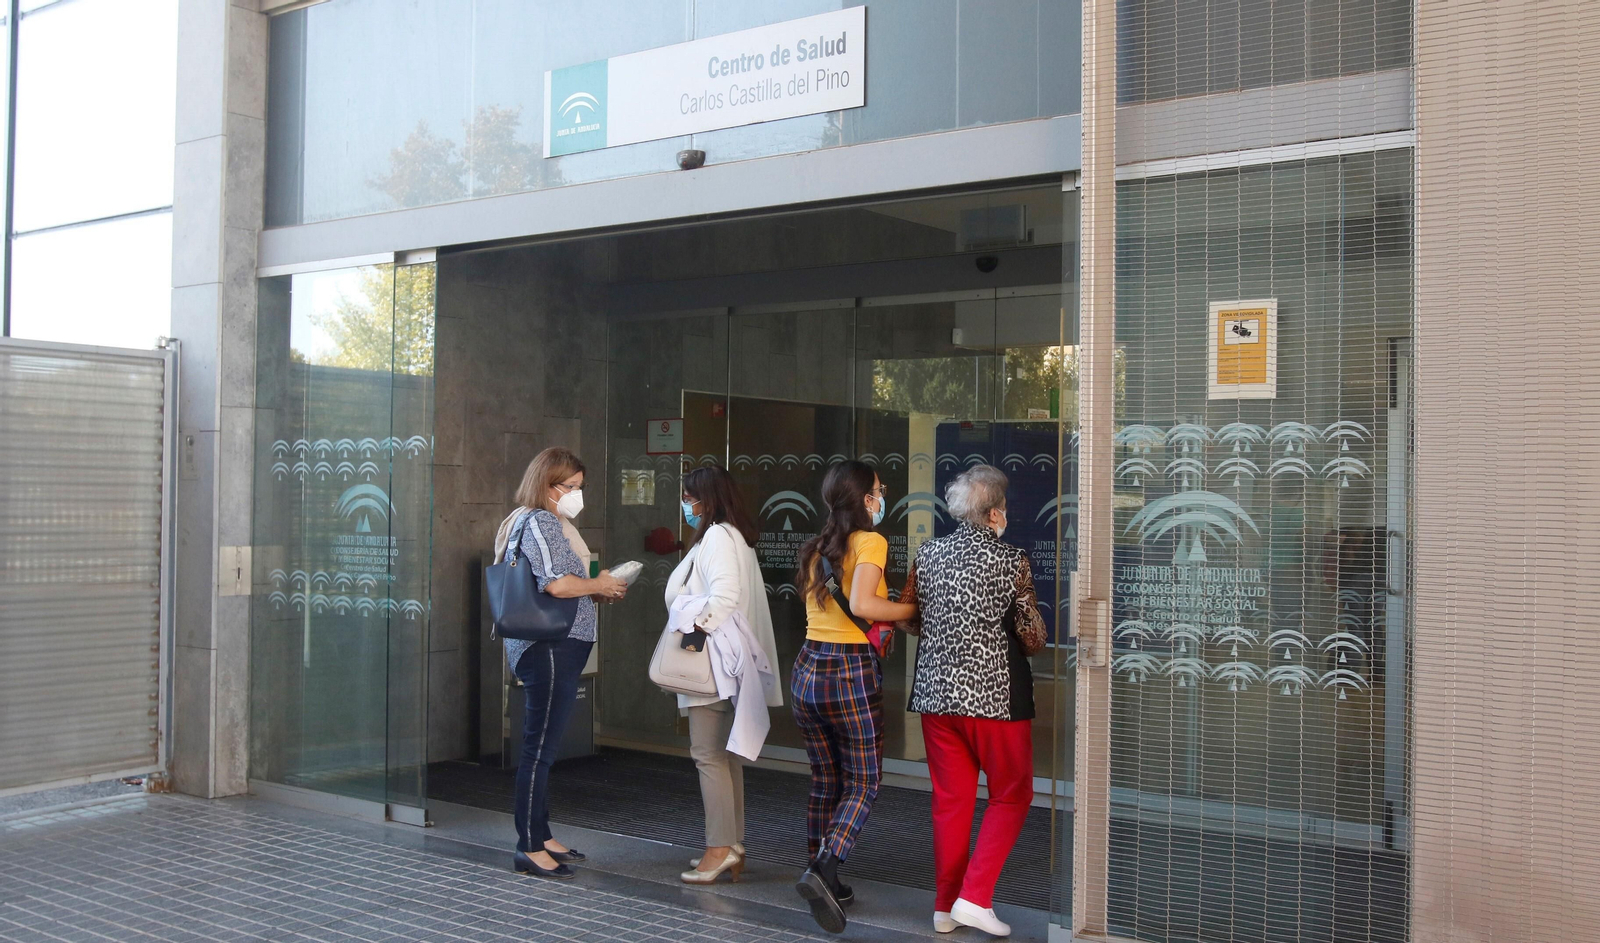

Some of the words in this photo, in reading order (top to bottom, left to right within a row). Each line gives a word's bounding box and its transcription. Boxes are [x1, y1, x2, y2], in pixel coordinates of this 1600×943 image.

[708, 53, 765, 79] Centro
[770, 44, 791, 68] de
[796, 31, 847, 62] Salud
[680, 90, 724, 115] Carlos
[729, 78, 782, 107] Castilla
[787, 71, 810, 96] del
[816, 68, 850, 92] Pino
[556, 128, 570, 137] JUNTA
[570, 127, 576, 135] DE
[759, 532, 776, 541] JUNTA
[777, 532, 785, 541] DE
[888, 535, 907, 545] JUNTA
[757, 541, 790, 549] CONSEJERÍA
[1034, 540, 1056, 550] JUNTA
[764, 549, 795, 557] BIENESTAR
[1177, 566, 1191, 581] DE
[1206, 585, 1222, 596] DE
[1225, 586, 1267, 598] SALUD
[1215, 599, 1259, 611] SOCIAL
